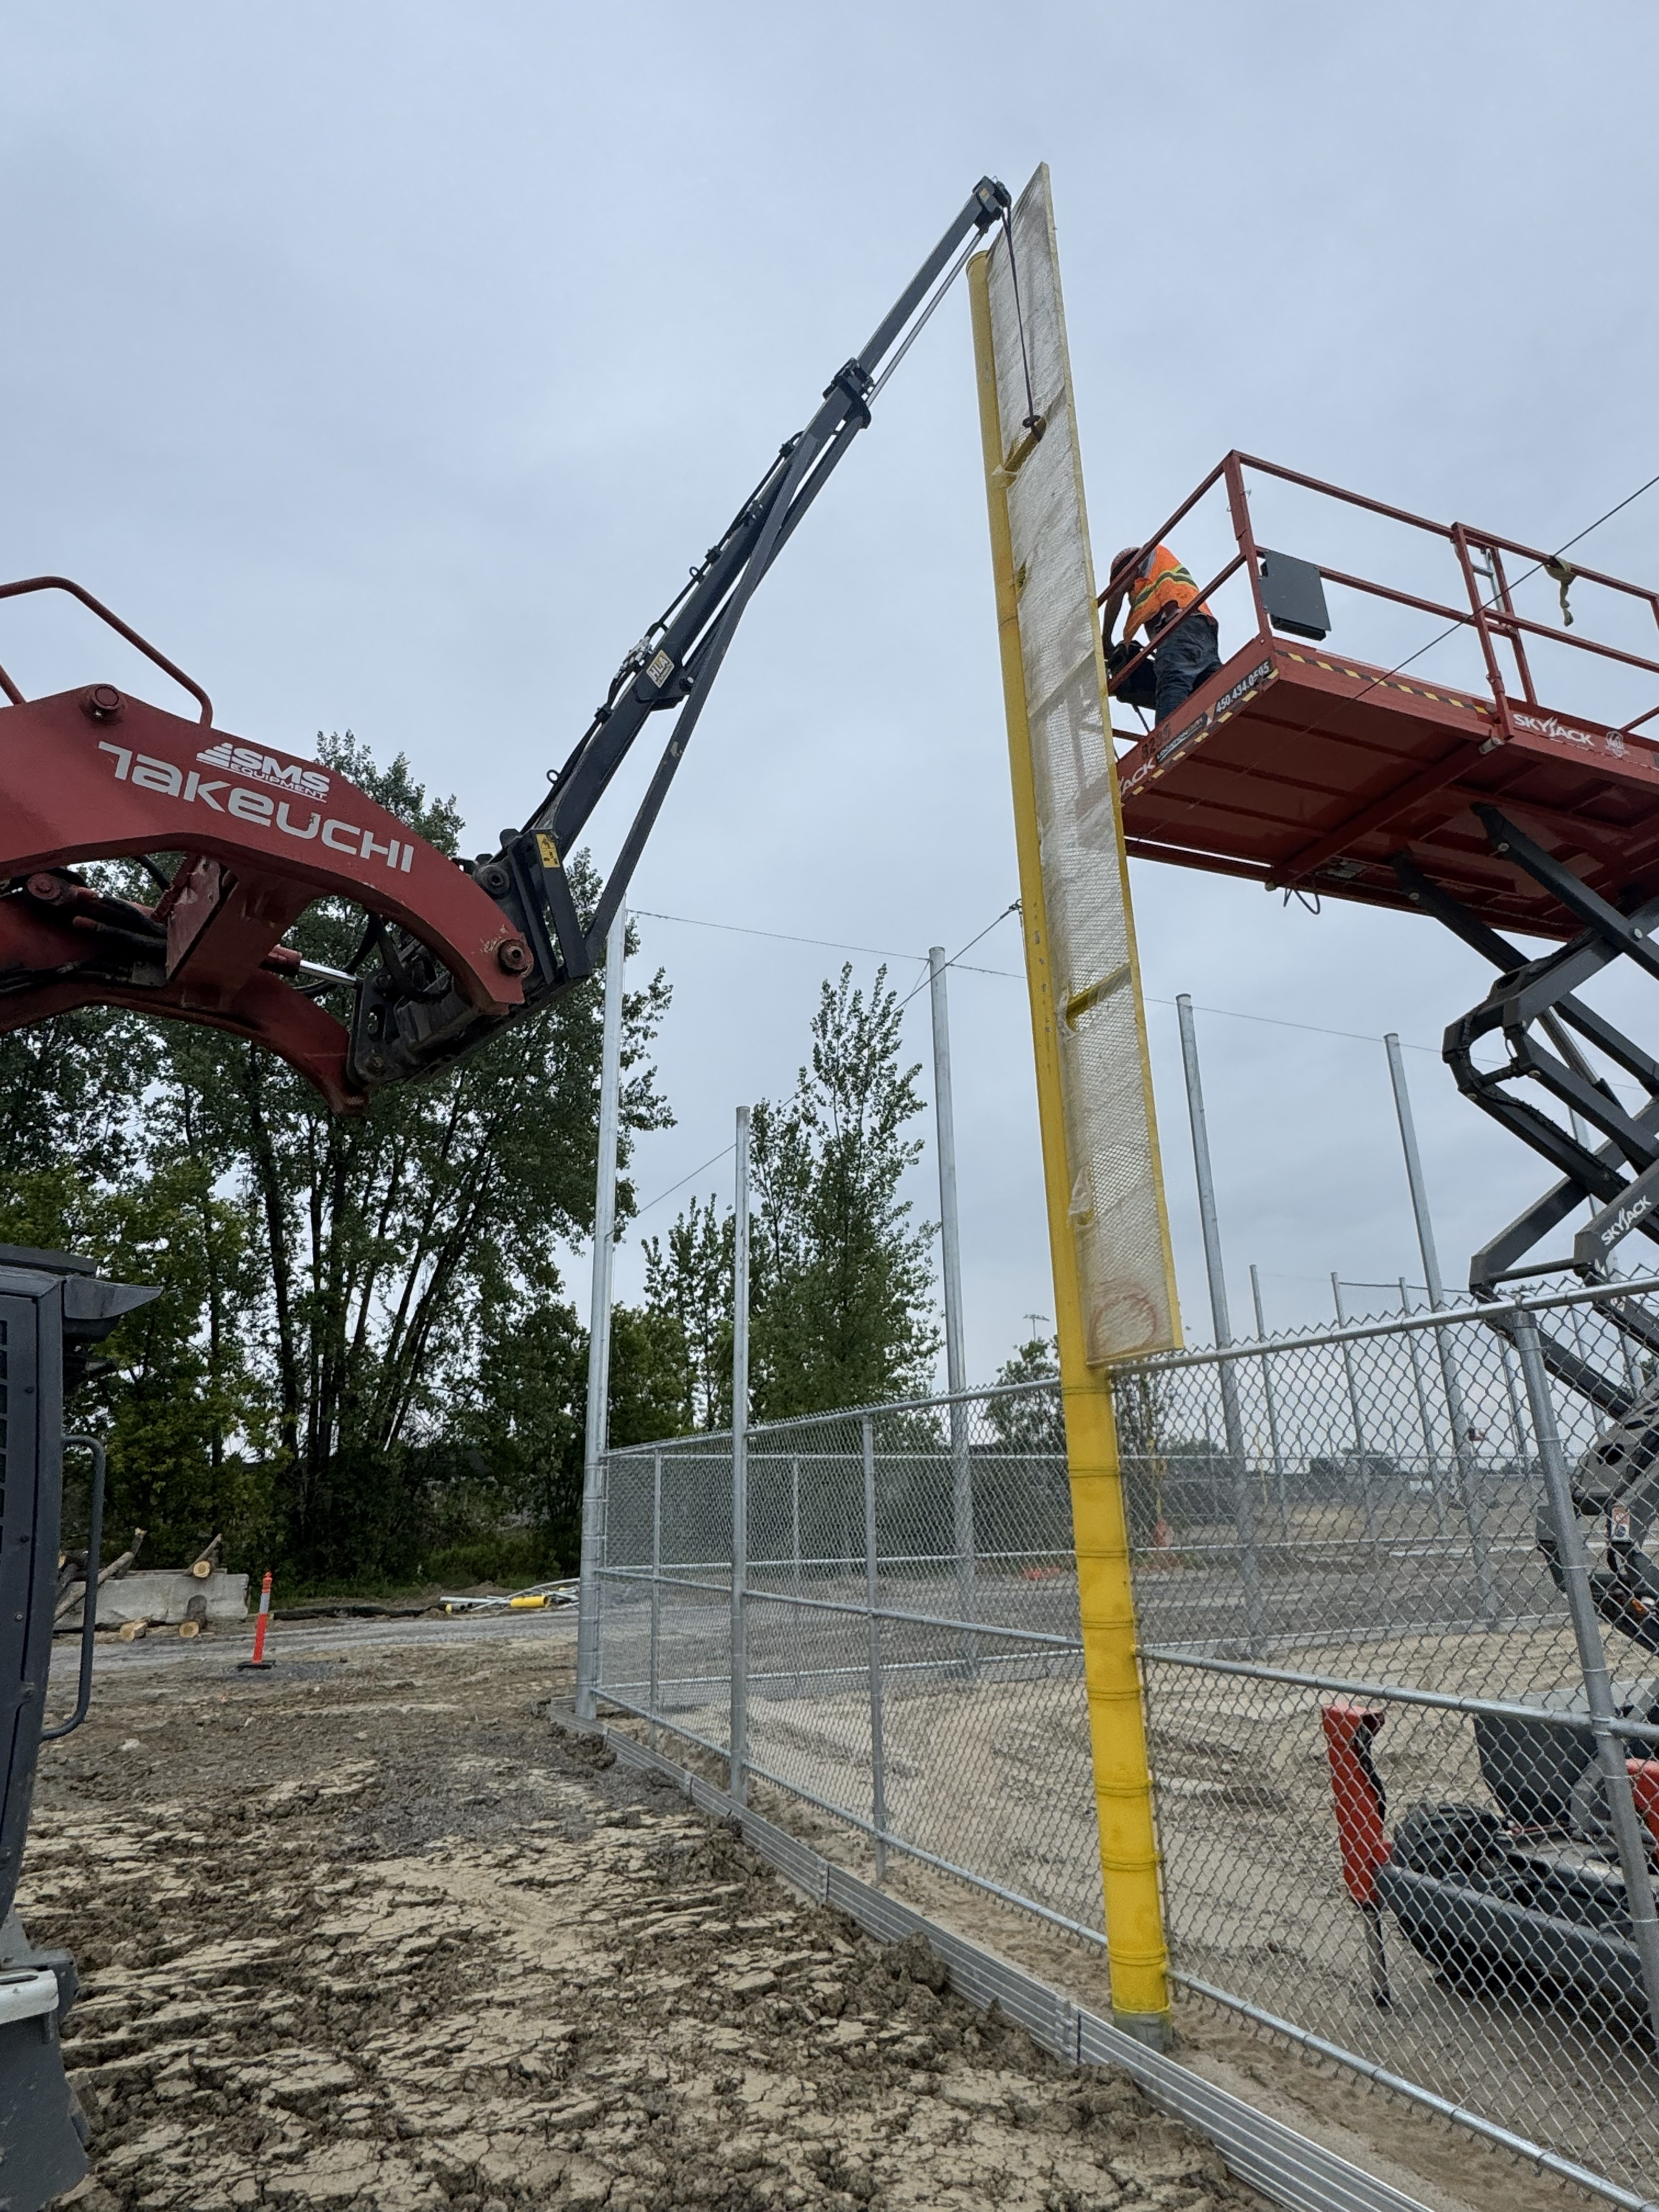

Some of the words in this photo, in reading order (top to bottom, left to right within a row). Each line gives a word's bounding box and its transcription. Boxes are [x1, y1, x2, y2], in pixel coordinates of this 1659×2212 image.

[649, 656, 668, 682] HLA
[1513, 713, 1595, 747] SKYJACK
[230, 763, 328, 799] EQUIPMENT
[231, 748, 330, 793] SMS
[1601, 1194, 1652, 1245] SKYJACK
